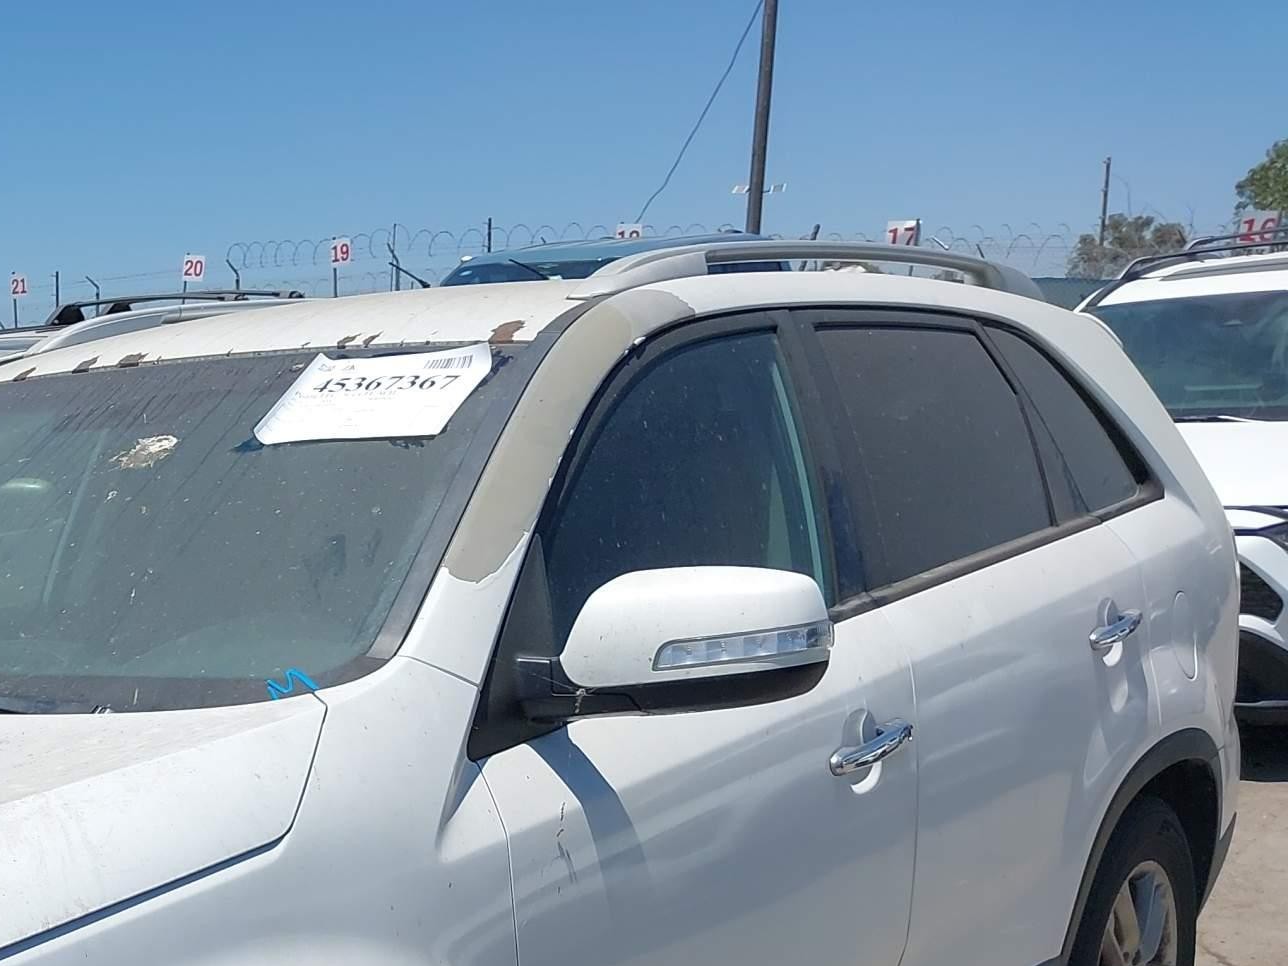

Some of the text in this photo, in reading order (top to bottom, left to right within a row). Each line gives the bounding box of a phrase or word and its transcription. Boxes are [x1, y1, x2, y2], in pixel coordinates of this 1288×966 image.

[888, 227, 915, 246] 17
[332, 243, 349, 262] 19
[183, 260, 204, 277] 20
[12, 278, 27, 294] 21
[313, 374, 461, 393] 45367367
